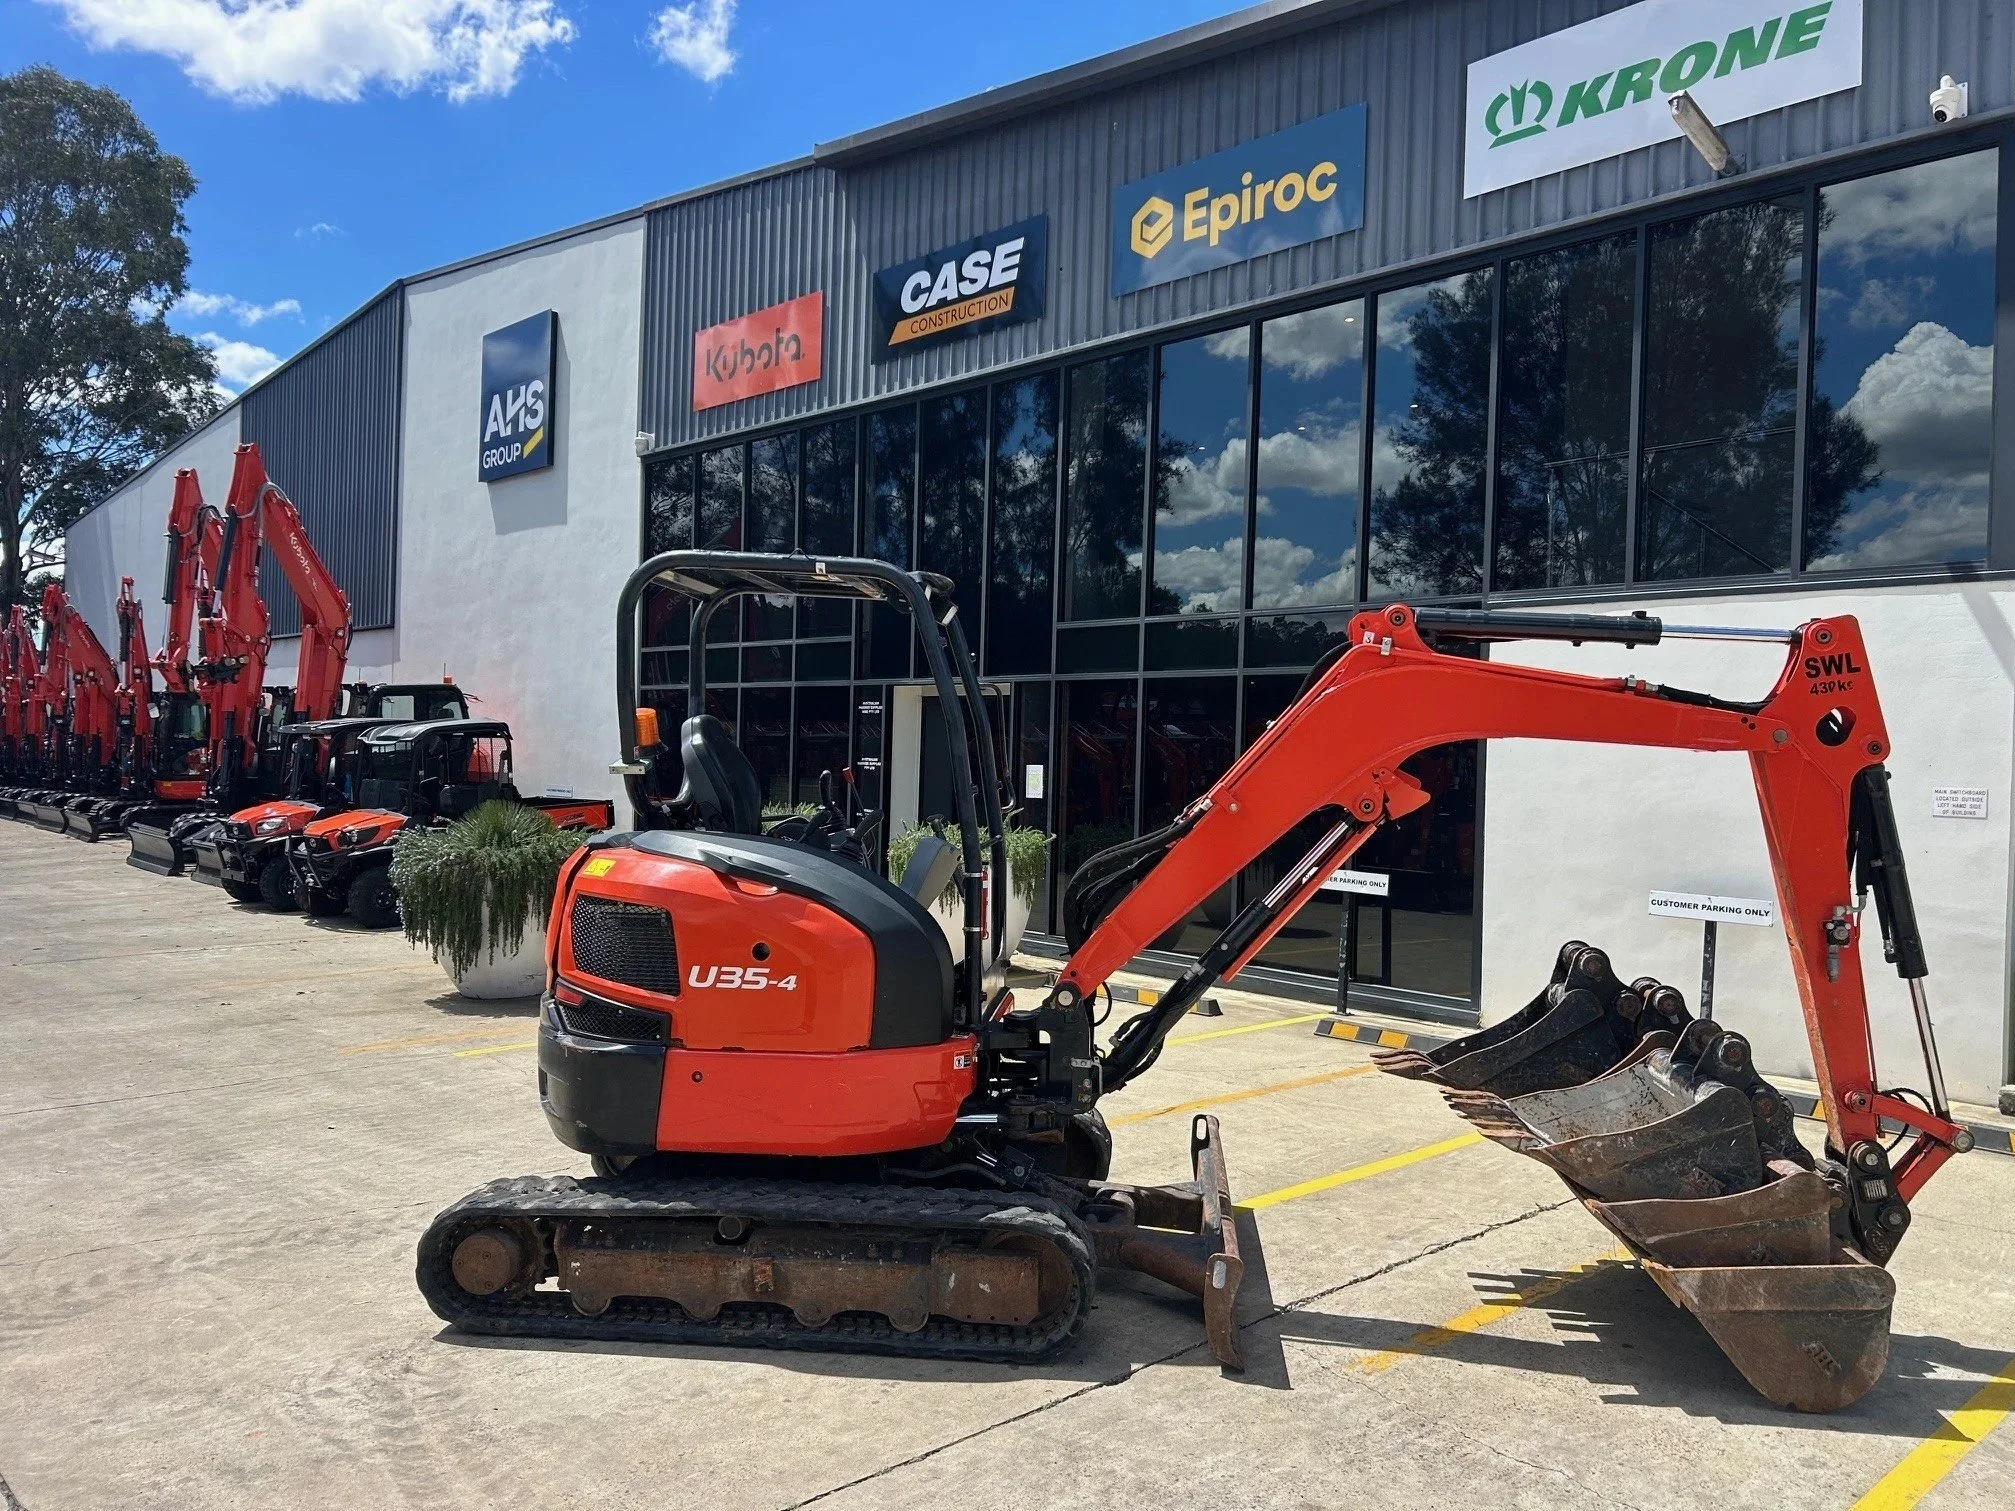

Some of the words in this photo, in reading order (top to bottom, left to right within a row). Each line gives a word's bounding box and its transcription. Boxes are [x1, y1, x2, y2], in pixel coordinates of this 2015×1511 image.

[1556, 1, 1833, 128] KRONE
[1183, 161, 1338, 247] Epiroc
[900, 236, 1025, 314] CASE
[910, 292, 1009, 334] CONSTRUCTION
[706, 326, 801, 383] Kubota
[483, 379, 544, 443] AHS
[482, 442, 522, 469] GROUP
[1804, 652, 1862, 679] SWL
[1339, 877, 1368, 887] PARKING
[1368, 880, 1387, 888] ONLY
[1650, 898, 1699, 910] CUSTOMER
[1701, 903, 1742, 915] PARKING
[1744, 907, 1771, 917] ONLY
[687, 965, 798, 991] U35-4
